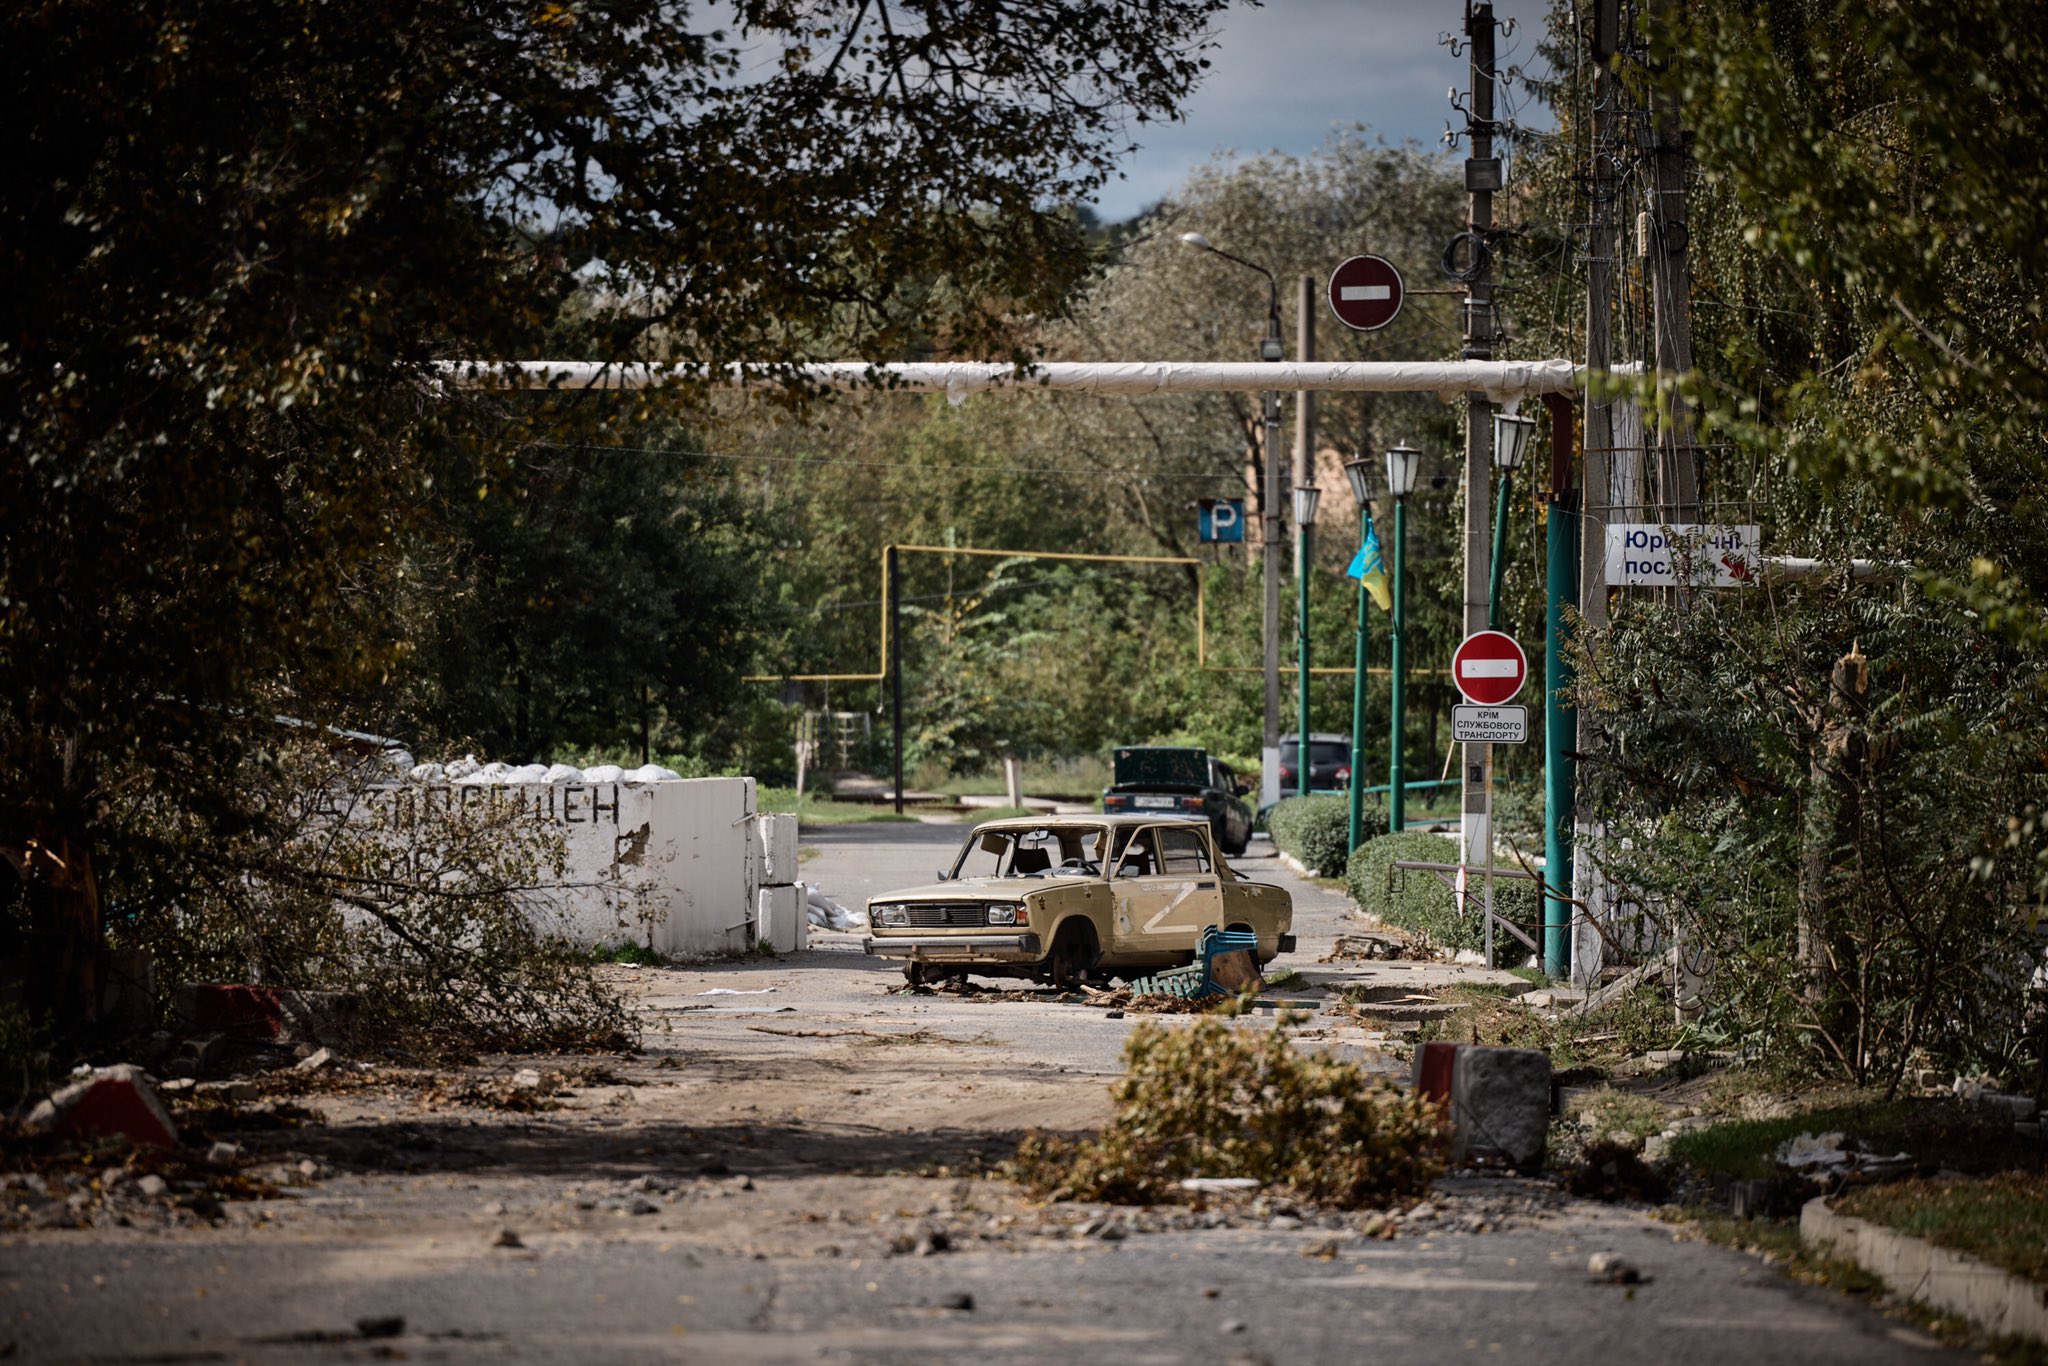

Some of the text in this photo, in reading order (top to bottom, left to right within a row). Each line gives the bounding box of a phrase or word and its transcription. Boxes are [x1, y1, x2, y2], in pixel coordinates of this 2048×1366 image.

[1210, 504, 1237, 540] P
[1477, 711, 1499, 719] КРІМ
[1456, 720, 1522, 730] СЛУЖБОВОГО
[1458, 731, 1519, 739] ТРАНСПОРТУ
